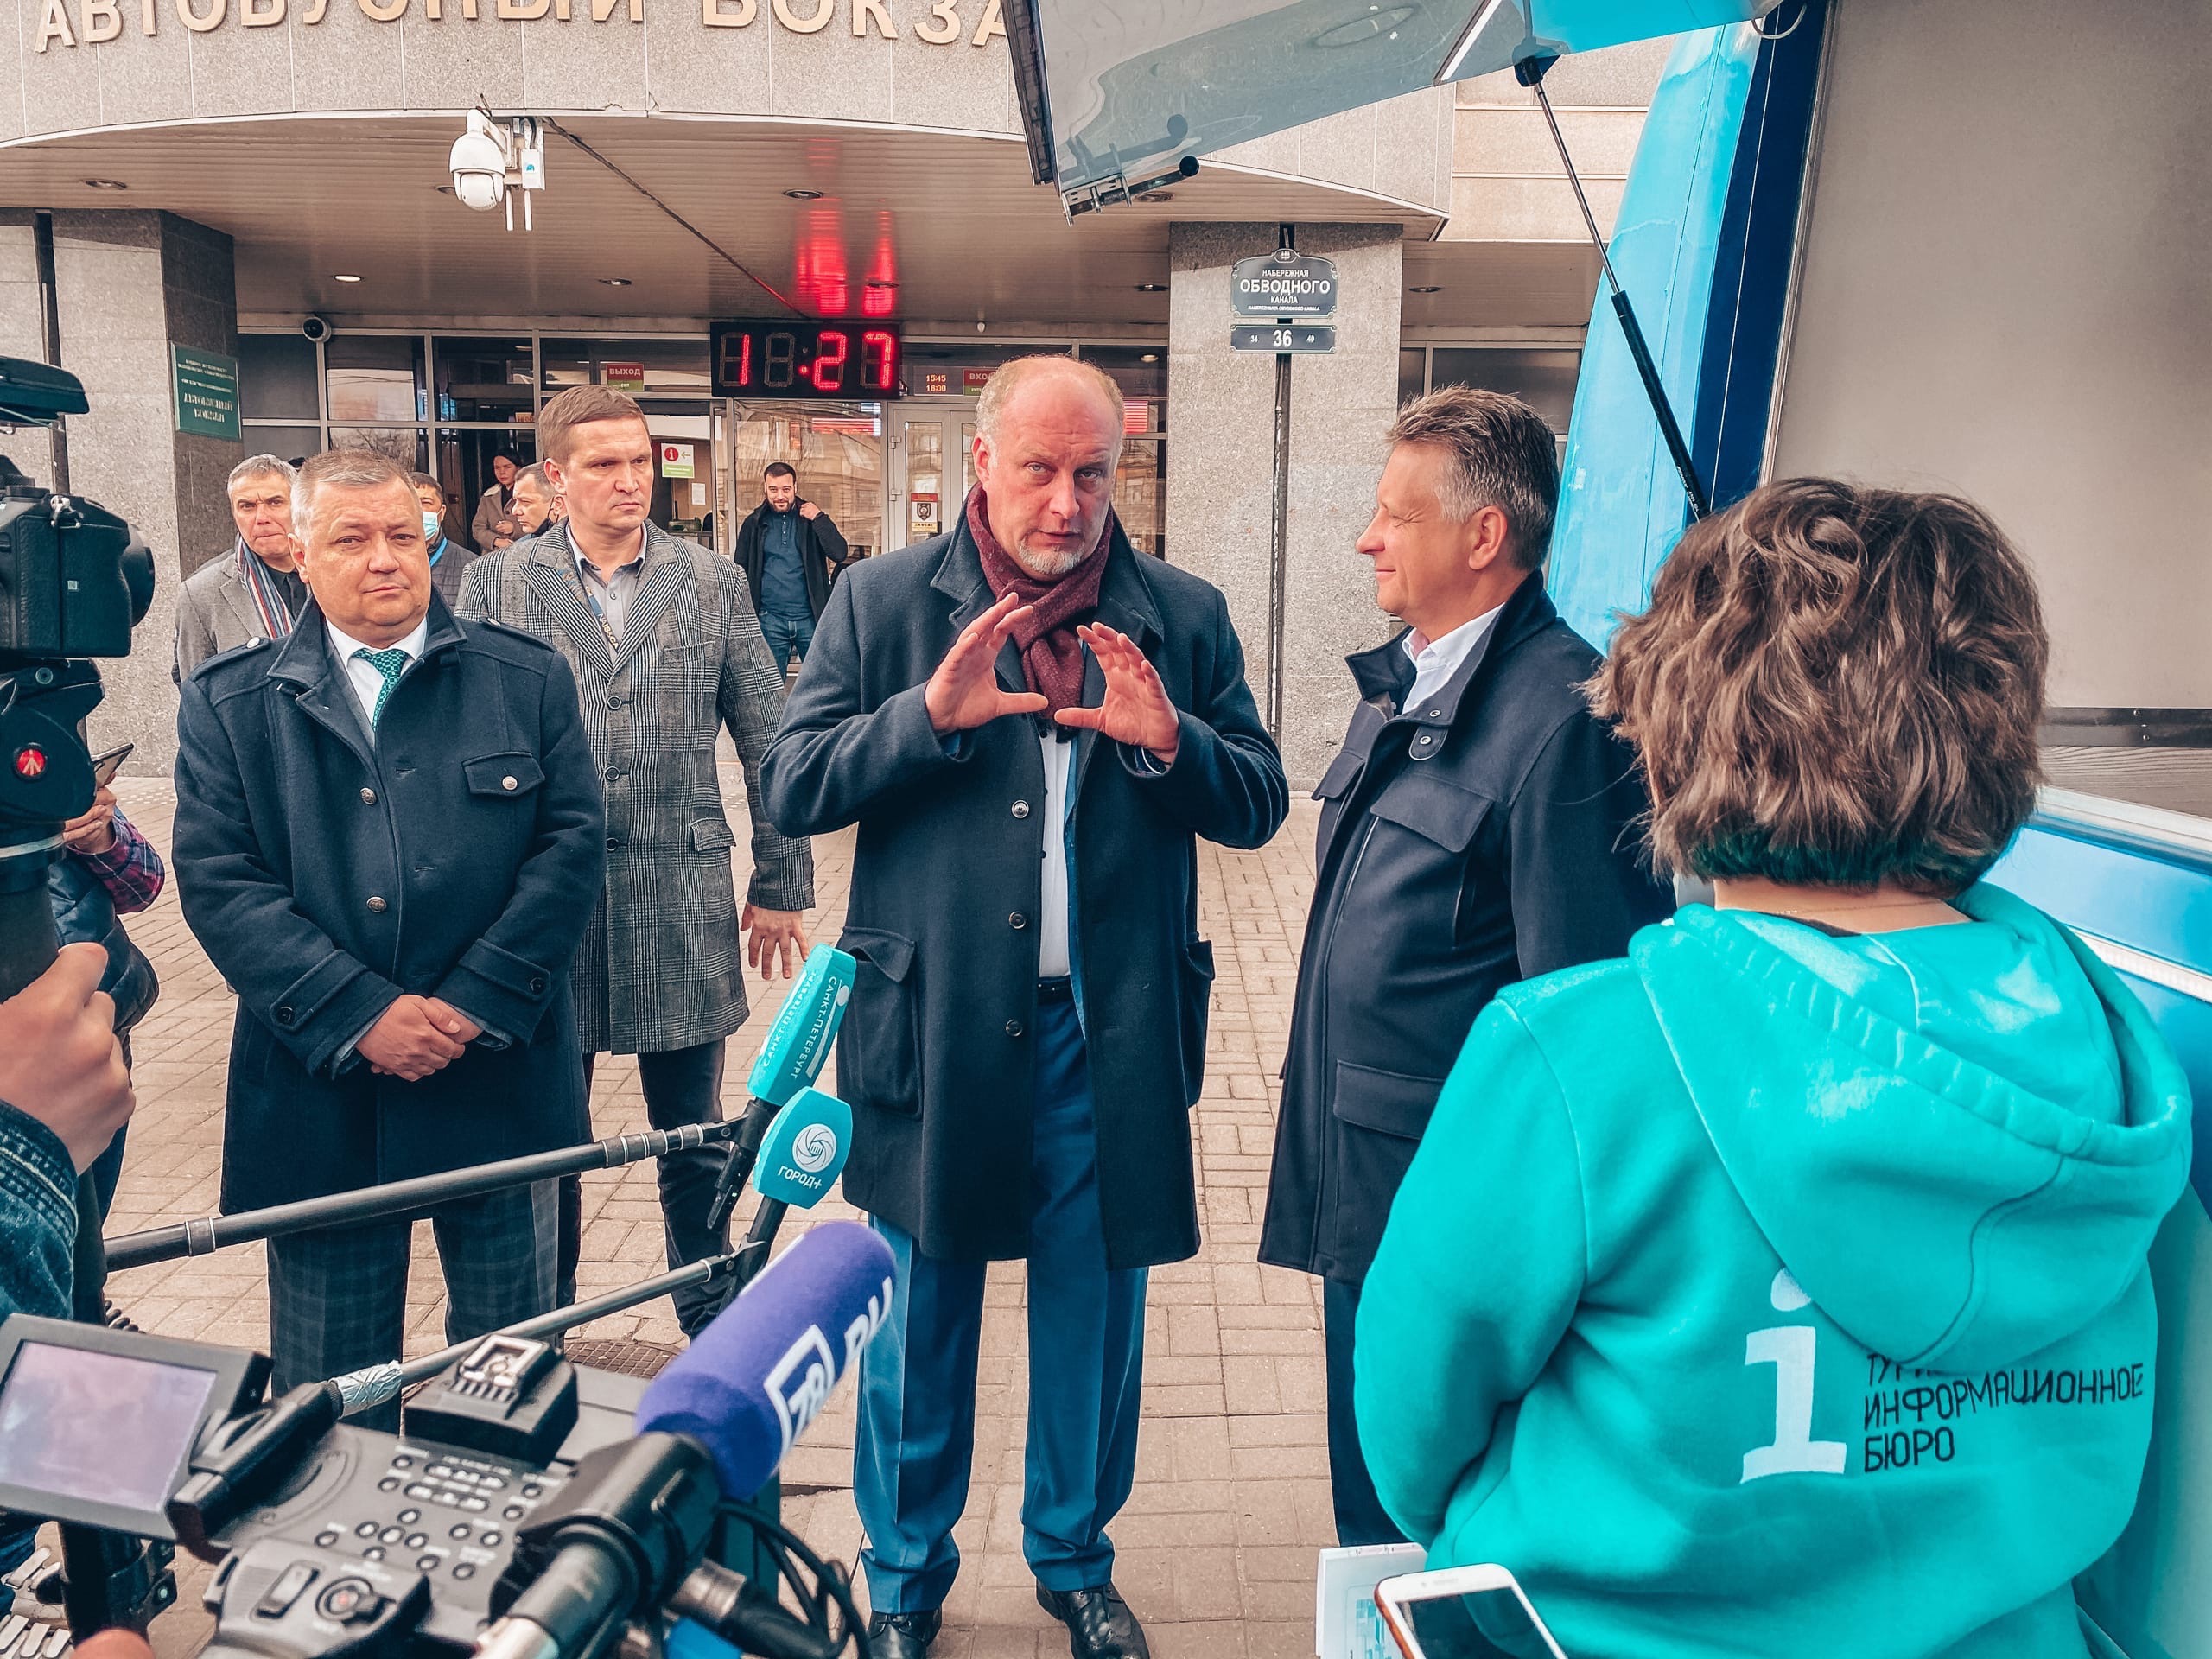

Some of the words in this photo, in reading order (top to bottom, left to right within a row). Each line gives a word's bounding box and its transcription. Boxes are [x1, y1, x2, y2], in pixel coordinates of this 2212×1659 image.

[1262, 269, 1309, 277] НАБЕРЕЖНАЯ
[1240, 278, 1331, 296] ОБВОДНОГО
[1273, 329, 1293, 347] 36
[609, 367, 641, 376] ВЫХОД
[926, 374, 946, 383] 15:45
[790, 976, 837, 1079] САНКТ-ПЕТЕРБУРГ
[778, 1166, 822, 1189] ГОРОД+
[1865, 1363, 2143, 1431] ИНФОРМАЦИОННОЕ
[1865, 1427, 1955, 1472] БЮРО
